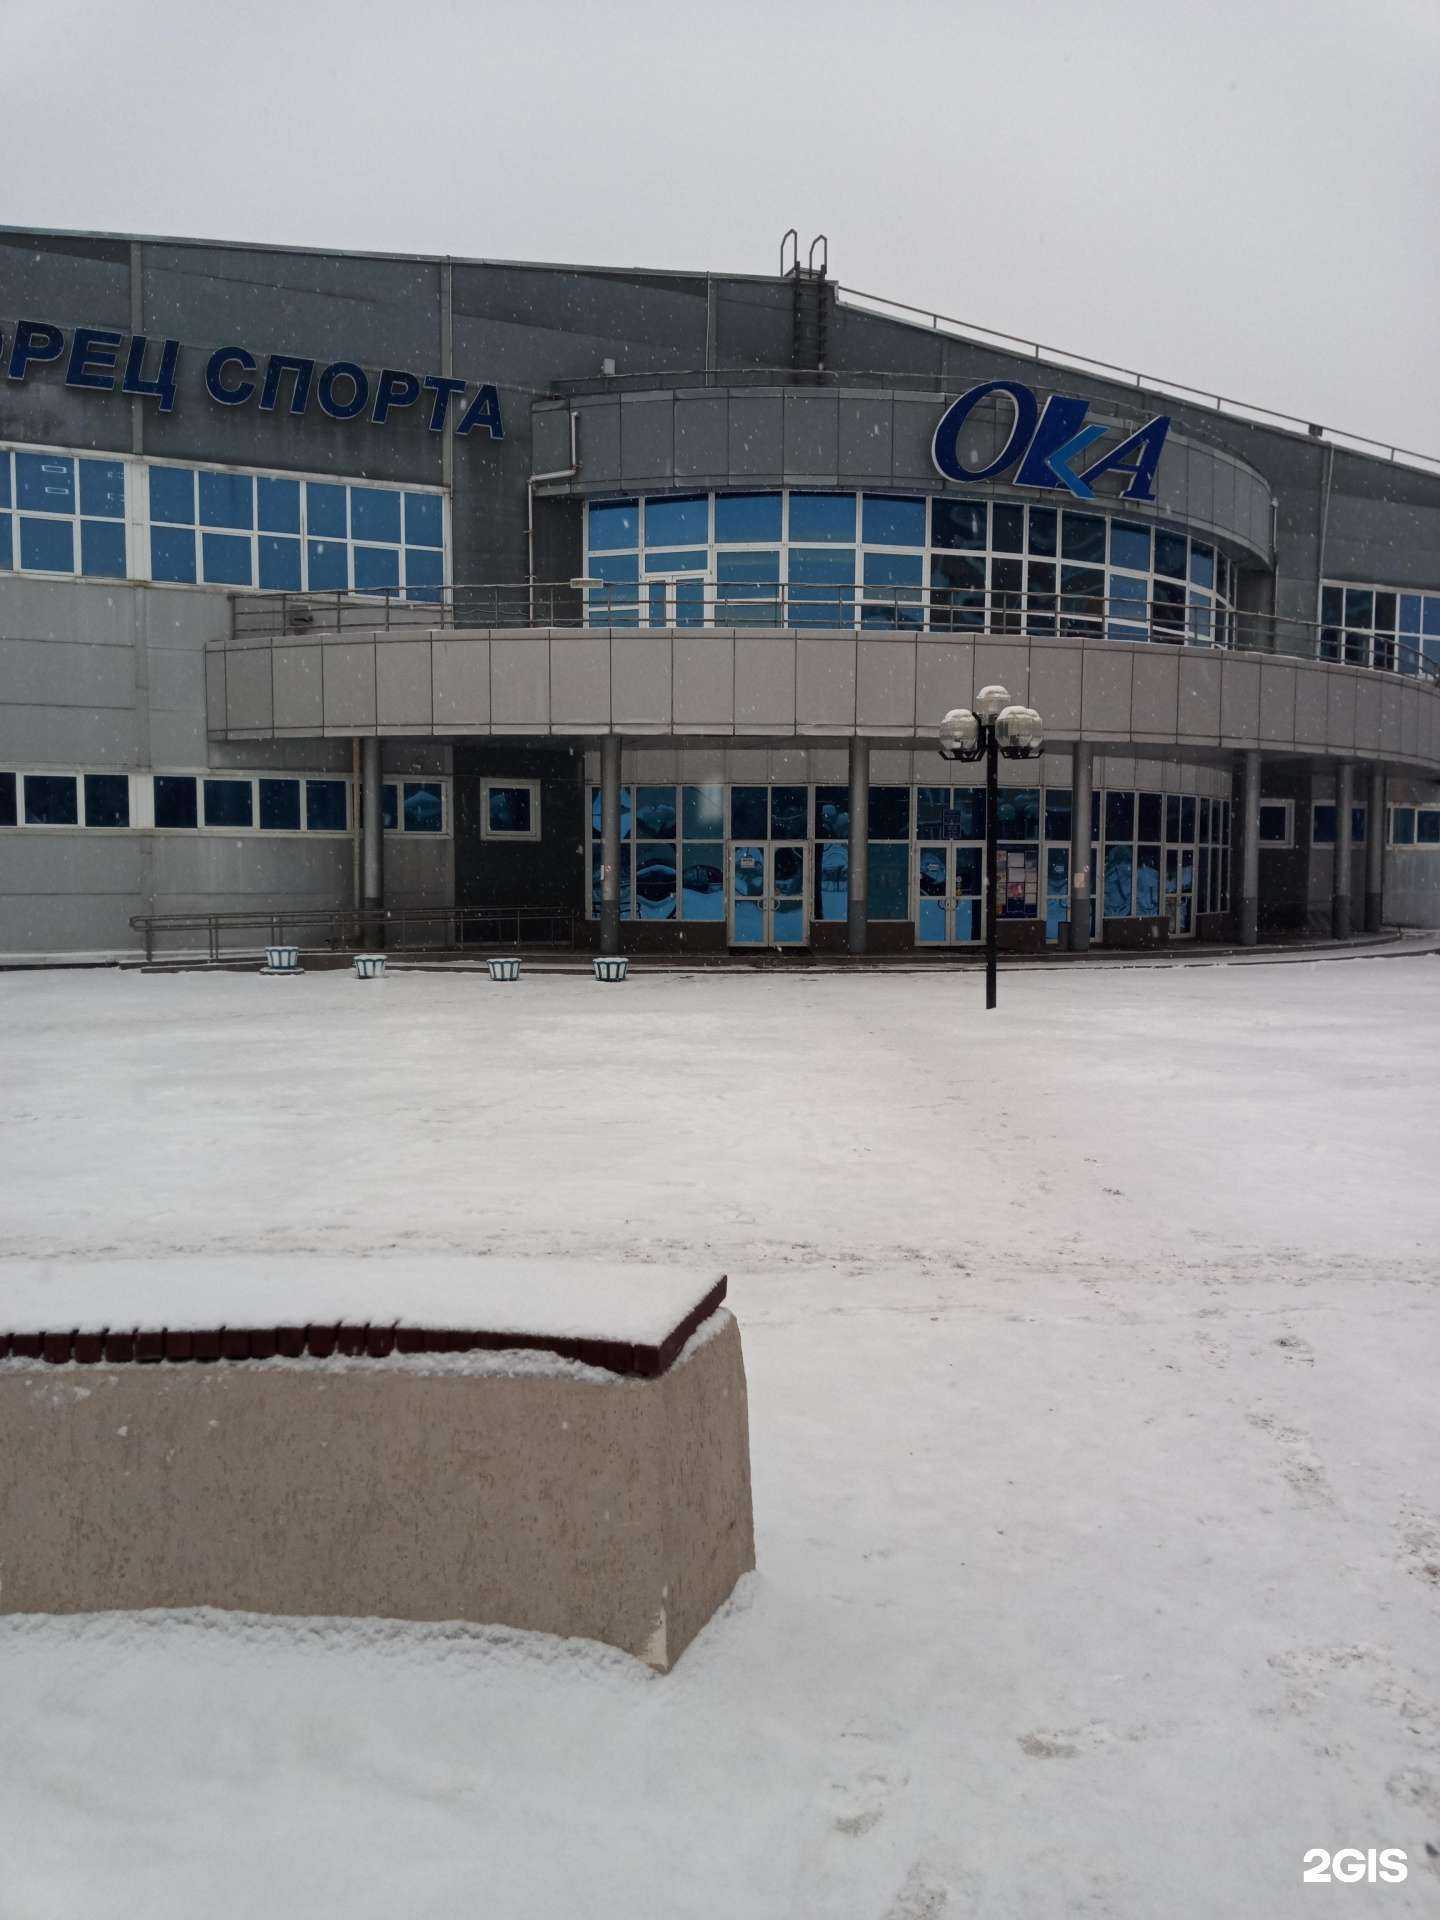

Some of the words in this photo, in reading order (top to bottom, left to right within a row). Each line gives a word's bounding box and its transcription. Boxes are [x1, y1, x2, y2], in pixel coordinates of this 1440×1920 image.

[0, 320, 181, 413] РЕЦ
[205, 346, 505, 440] СПОРТА
[931, 380, 1172, 500] ОКА
